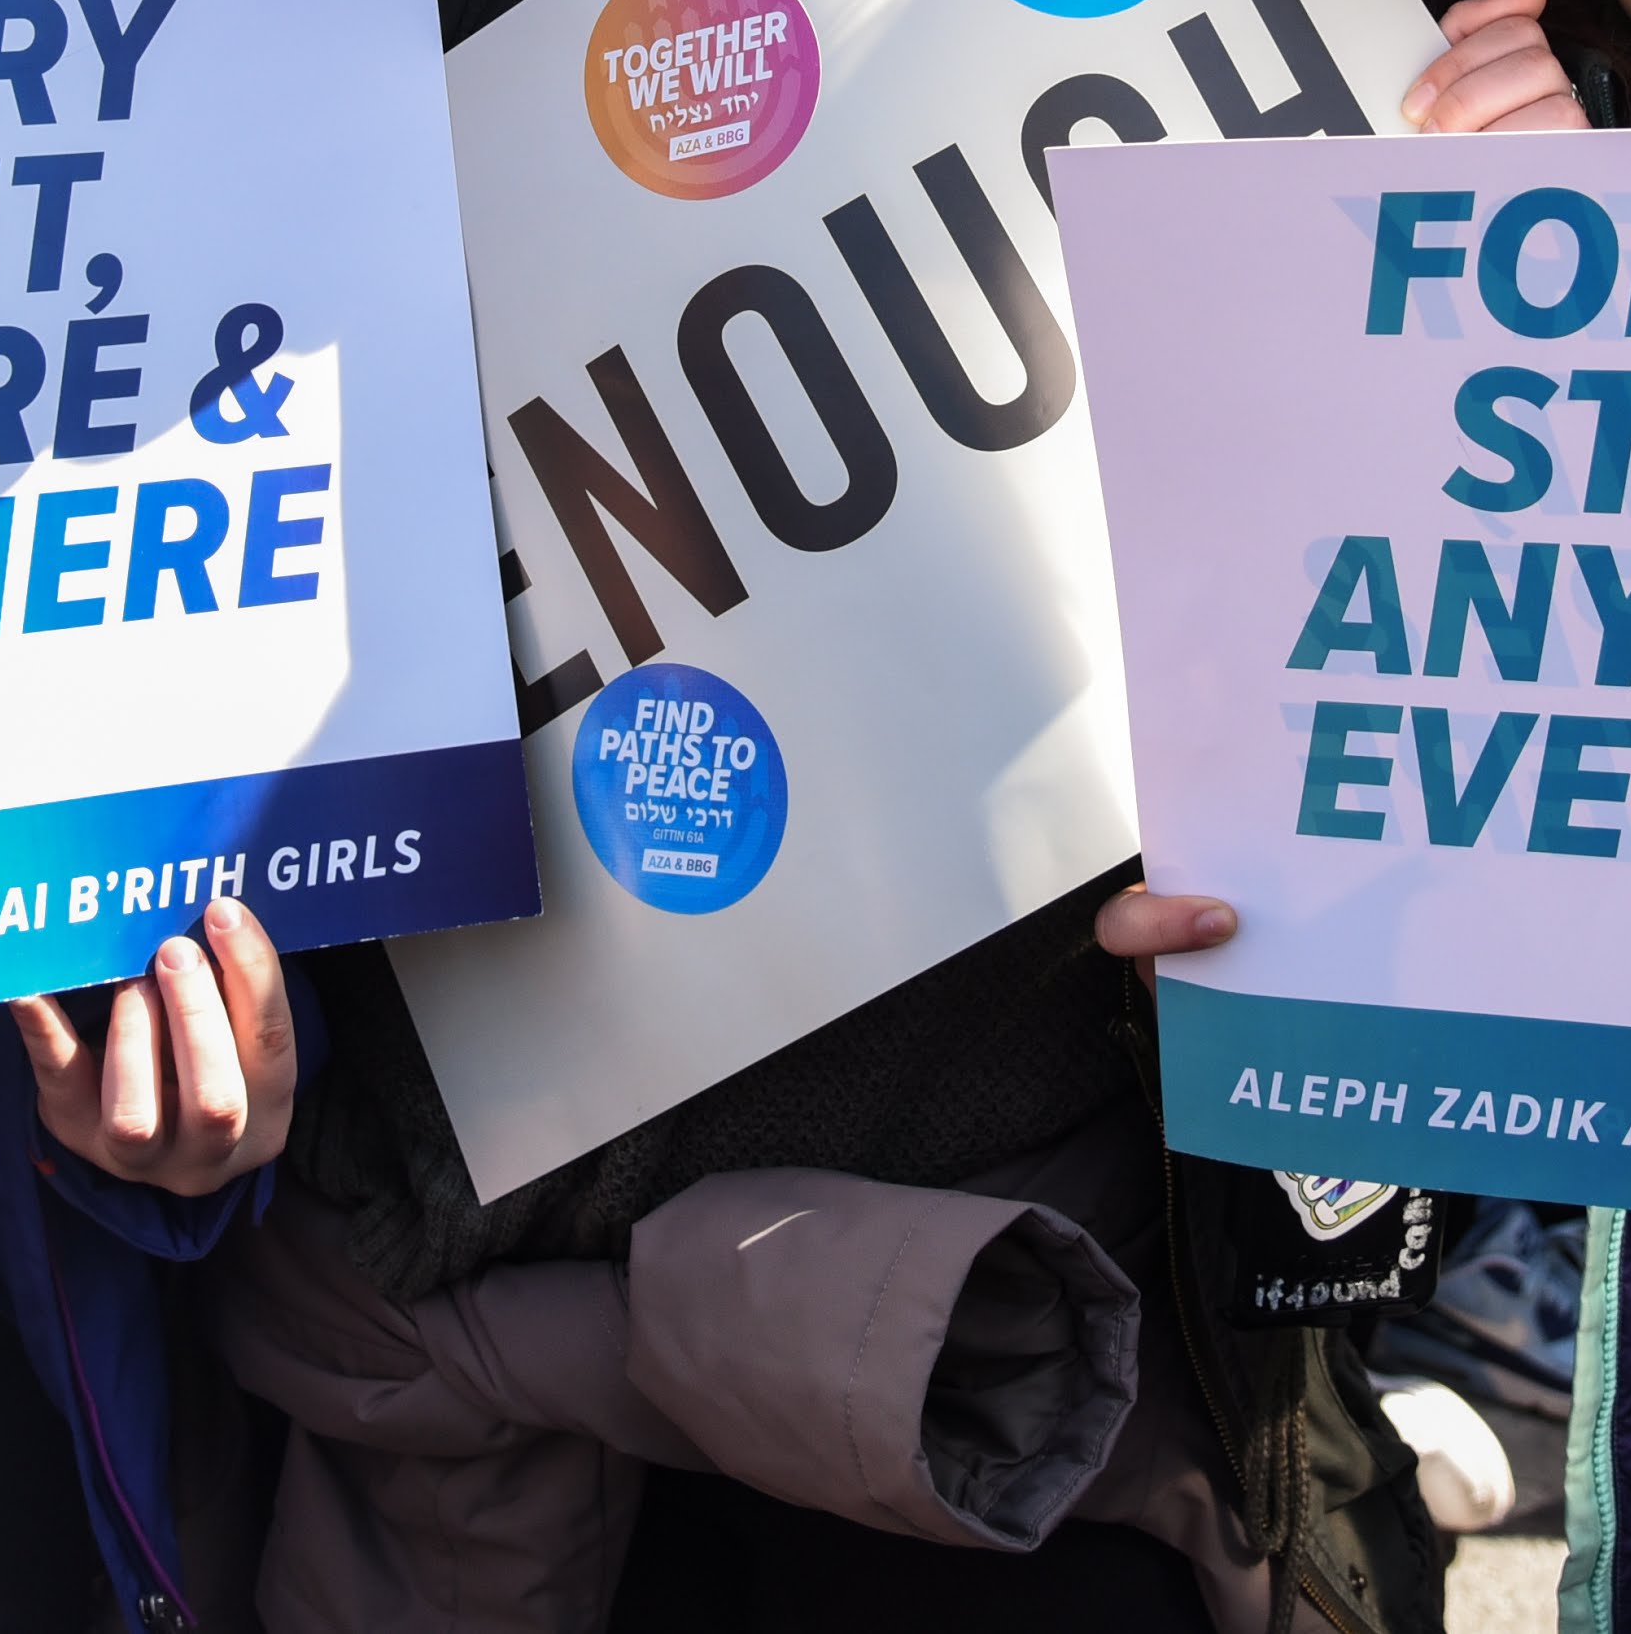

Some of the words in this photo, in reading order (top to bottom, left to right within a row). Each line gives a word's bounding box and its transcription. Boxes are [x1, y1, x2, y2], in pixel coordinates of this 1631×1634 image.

[603, 11, 788, 83] TOGETHER
[627, 68, 680, 111] WE
[689, 47, 773, 95] WILL
[649, 102, 712, 133] נצליח
[720, 91, 760, 116] יחד
[675, 138, 701, 156] AZA
[704, 135, 713, 148] &
[717, 128, 744, 145] BBG
[190, 302, 295, 444] &
[635, 699, 714, 735] FIND
[599, 729, 703, 767] PATHS
[712, 736, 756, 770] TO
[625, 763, 732, 802] PEACE
[624, 799, 677, 824] שלום
[686, 808, 733, 828] דרכי
[653, 828, 684, 843] GITTIN
[687, 831, 704, 844] 61A
[67, 853, 246, 924] B'RITH
[267, 829, 423, 893] GIRLS
[648, 855, 671, 870] AZA
[674, 857, 682, 870] &
[686, 858, 712, 873] BBG
[1230, 1066, 1409, 1124] ALEPH
[1428, 1085, 1606, 1144] ZADIK
